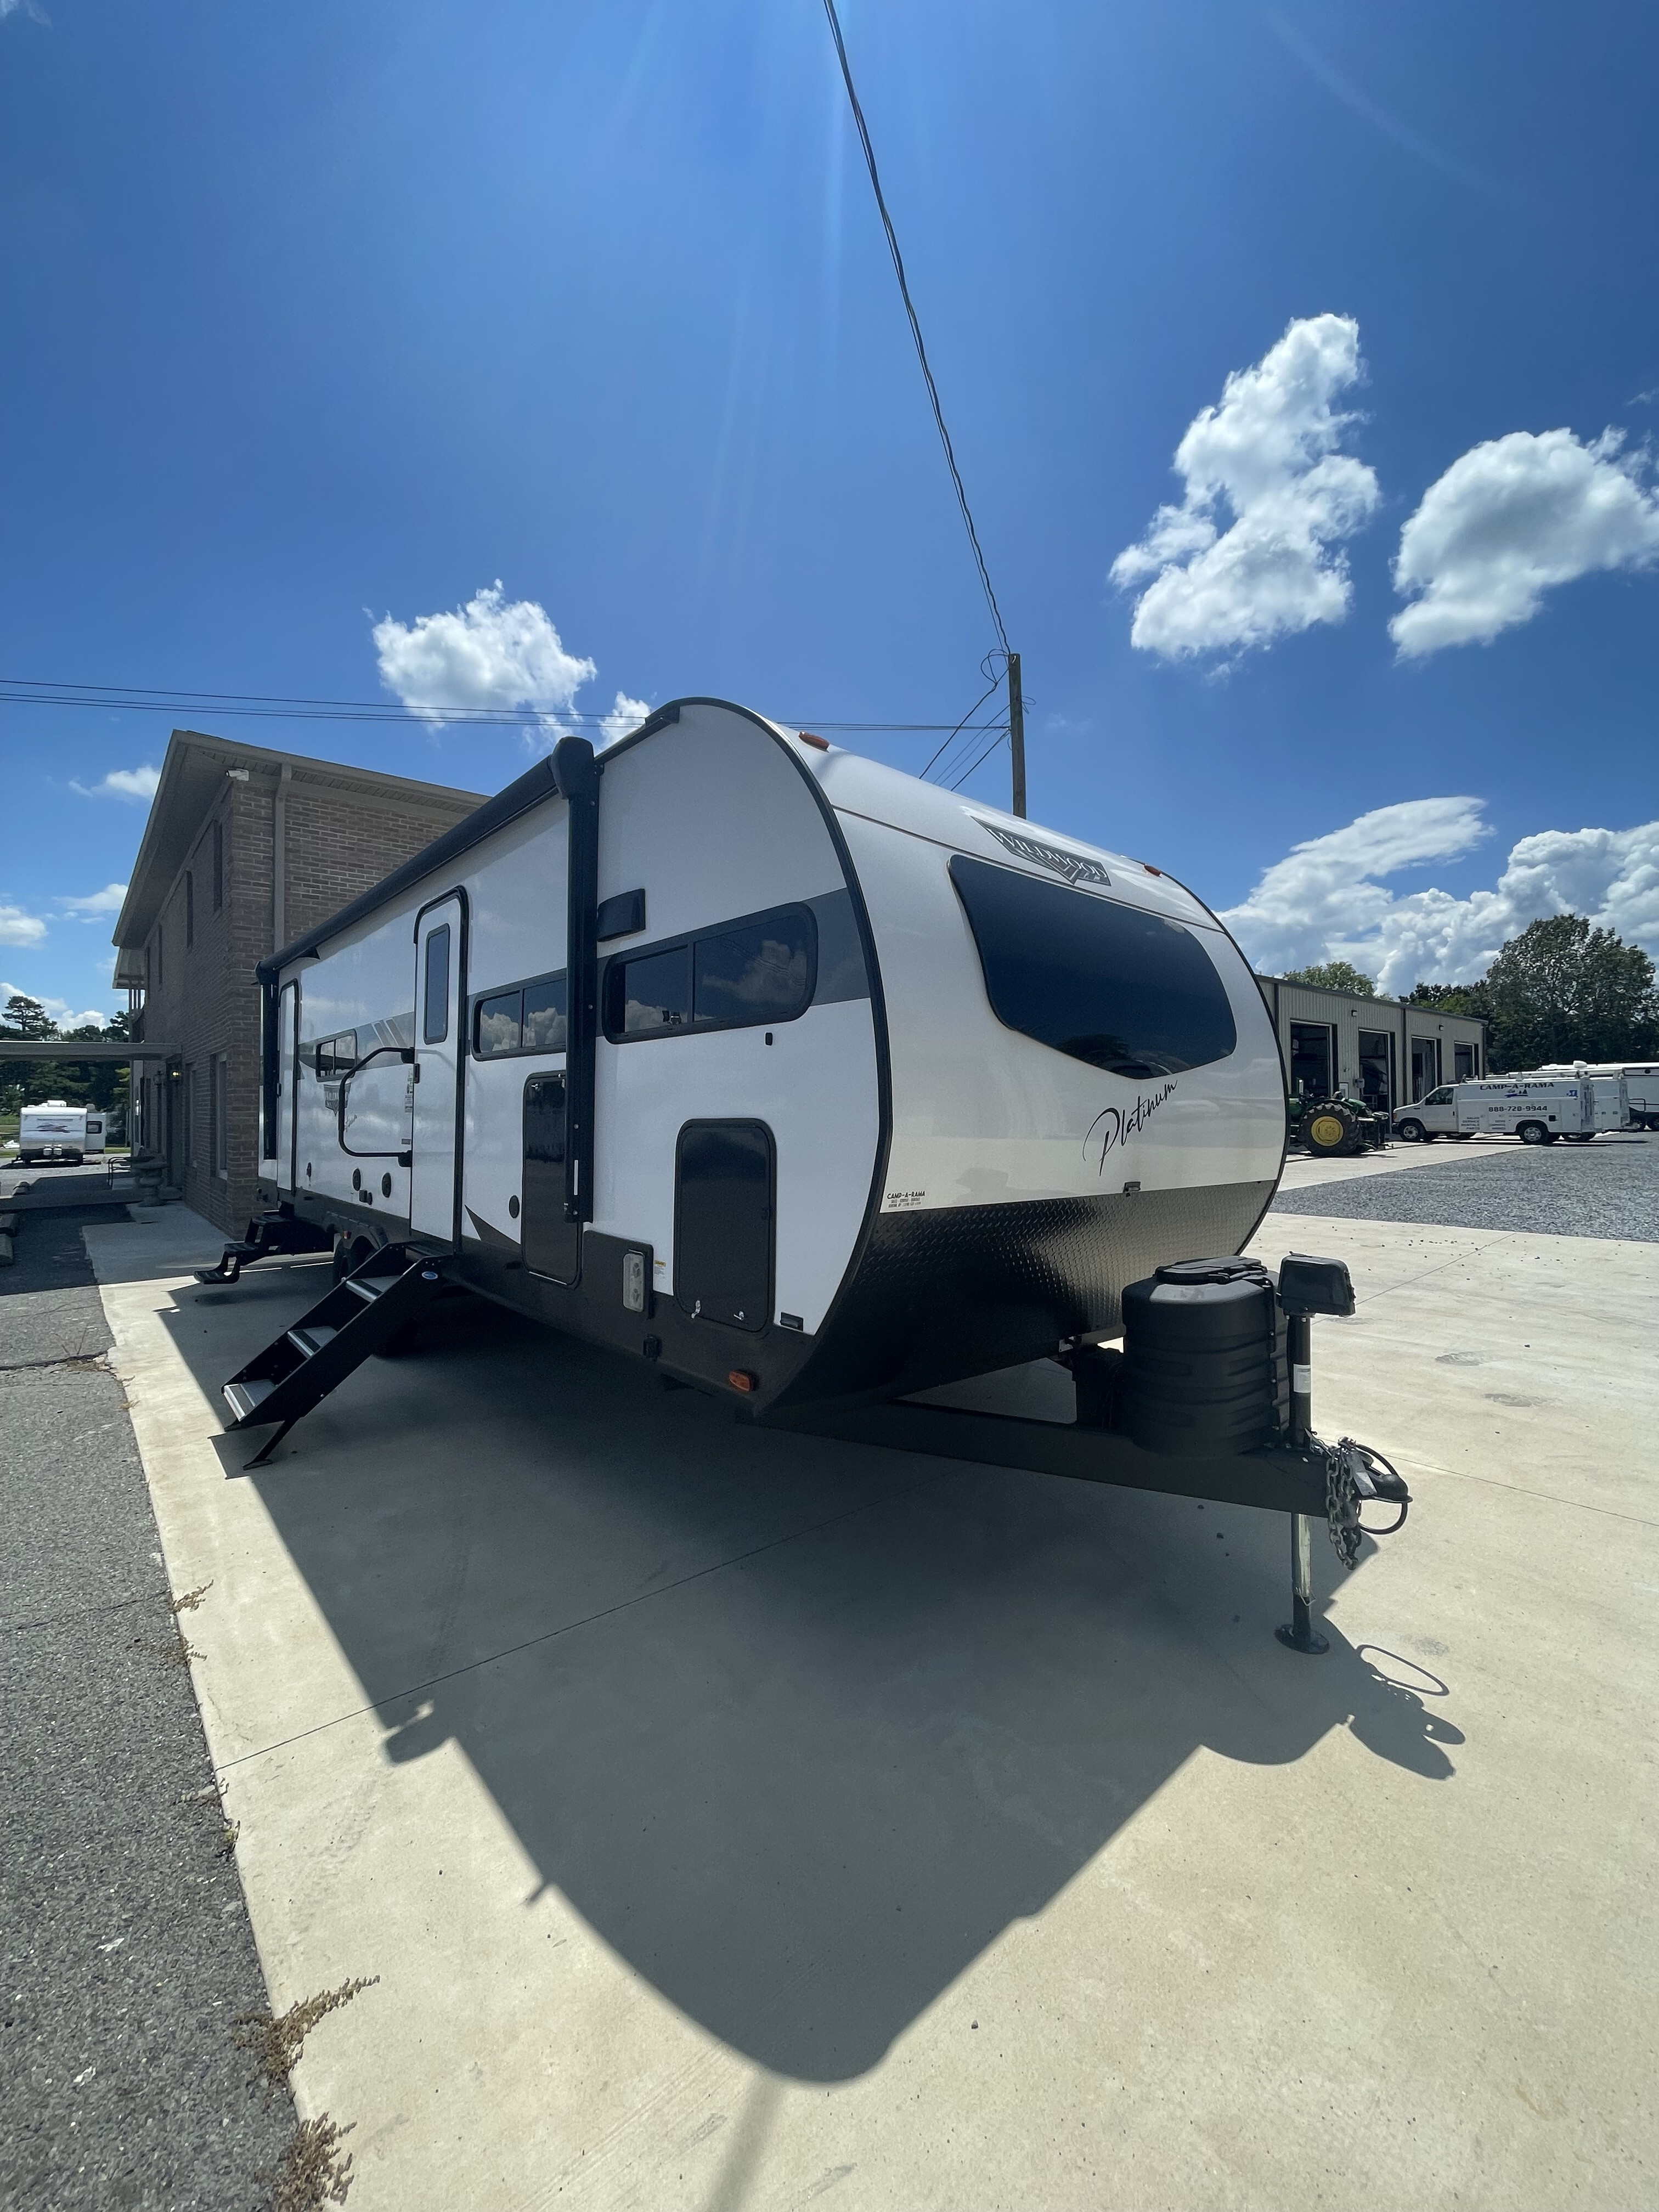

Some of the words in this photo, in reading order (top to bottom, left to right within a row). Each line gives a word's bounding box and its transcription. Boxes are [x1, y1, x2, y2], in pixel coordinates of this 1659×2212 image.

[986, 827, 1107, 878] WILDWOOD
[1082, 1080, 1178, 1176] Platinum
[887, 1190, 925, 1199] CAMP-A-RAMA
